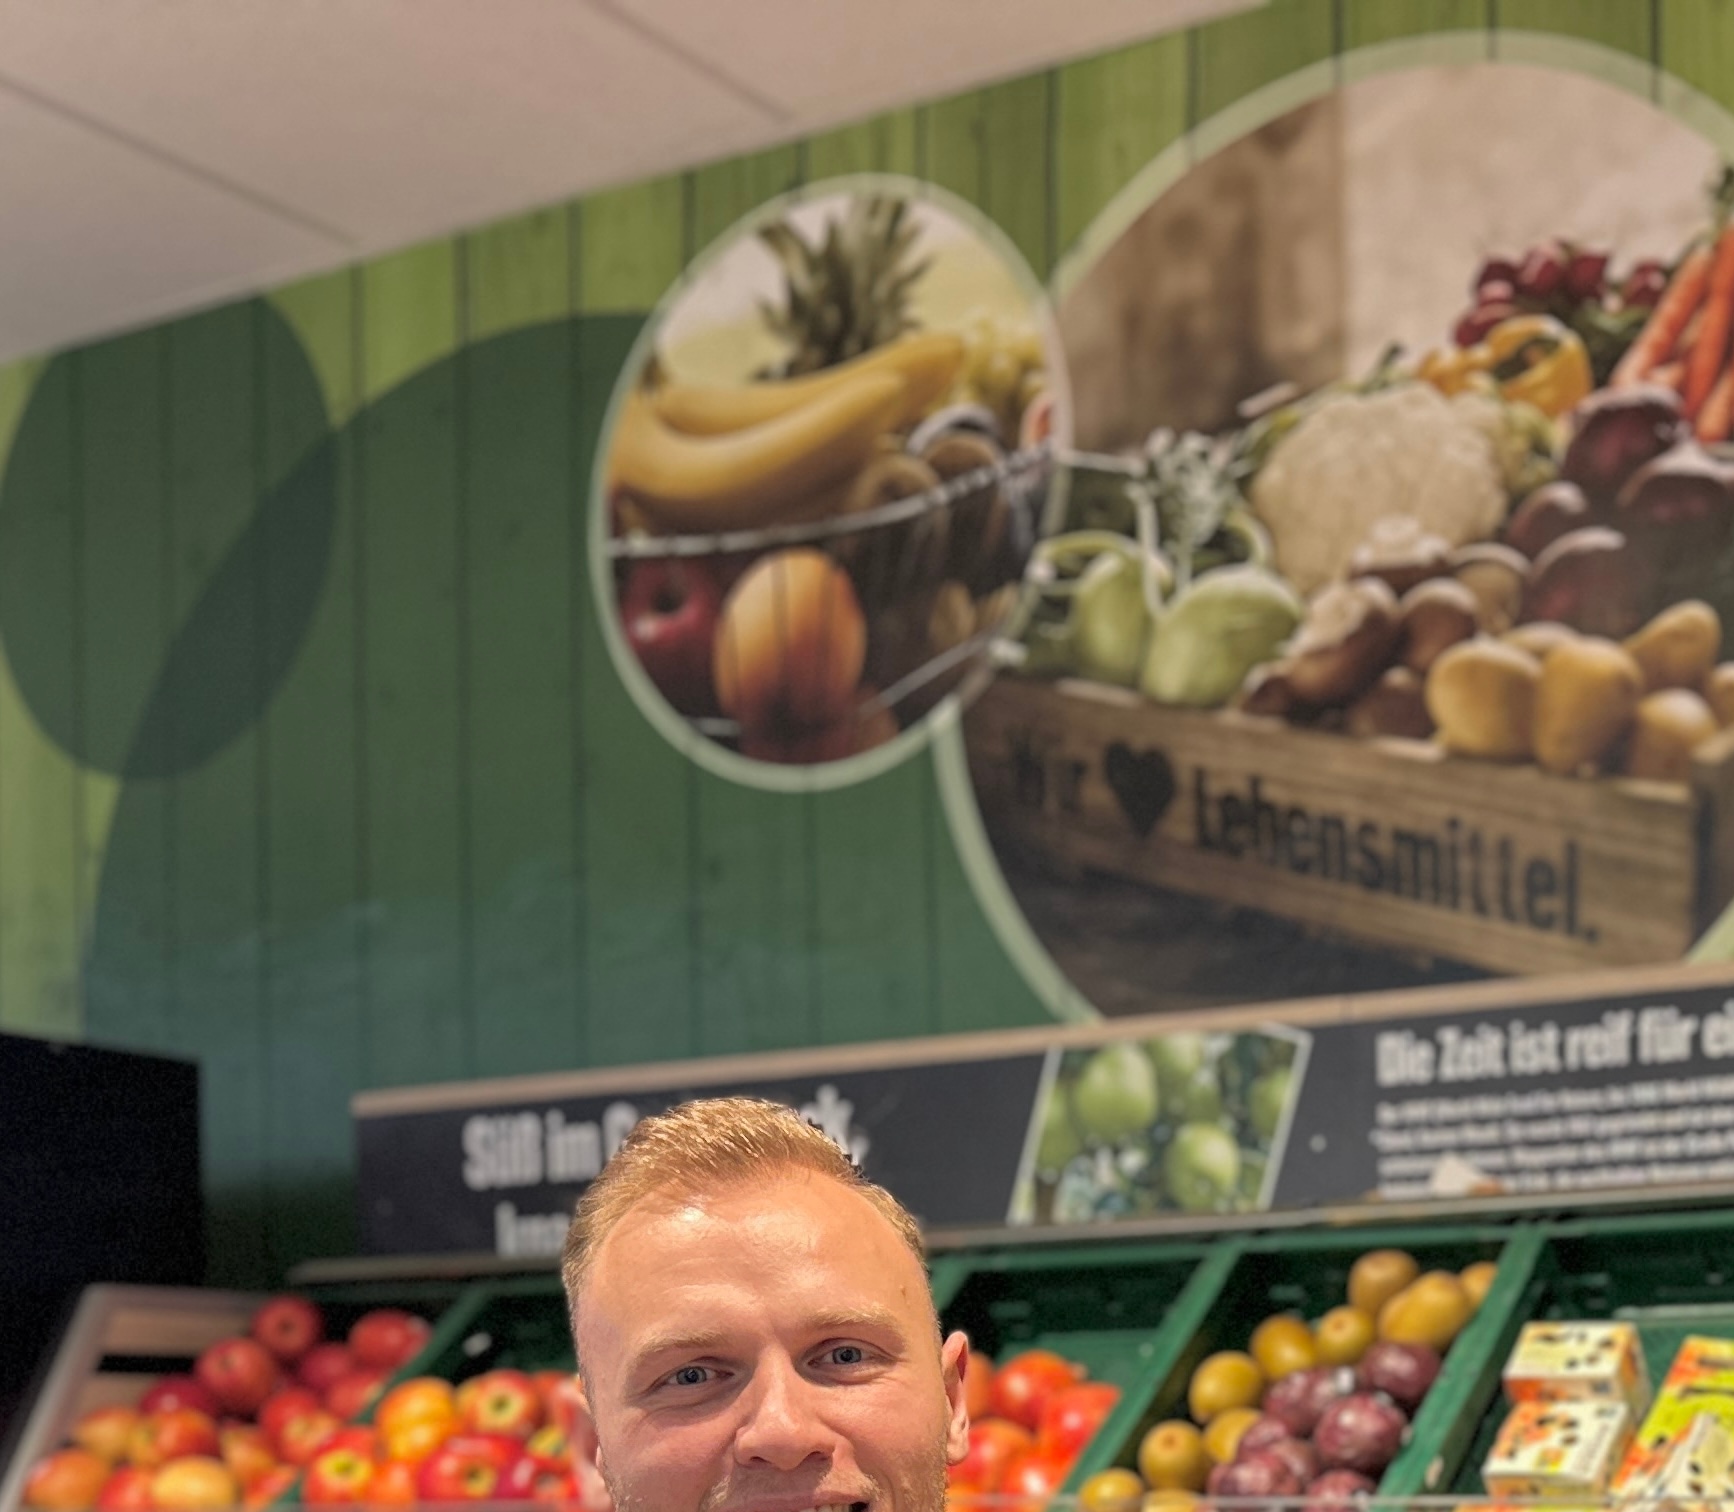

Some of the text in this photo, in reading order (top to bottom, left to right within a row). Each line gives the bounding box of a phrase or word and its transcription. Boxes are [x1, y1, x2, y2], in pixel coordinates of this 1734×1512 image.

[1193, 768, 1598, 942] Lebensmittel.
[1375, 1028, 1433, 1087] Die
[1435, 1022, 1504, 1082] Zeit
[1507, 1018, 1560, 1075] ist
[1564, 1006, 1634, 1070] reif
[1637, 1003, 1698, 1065] für
